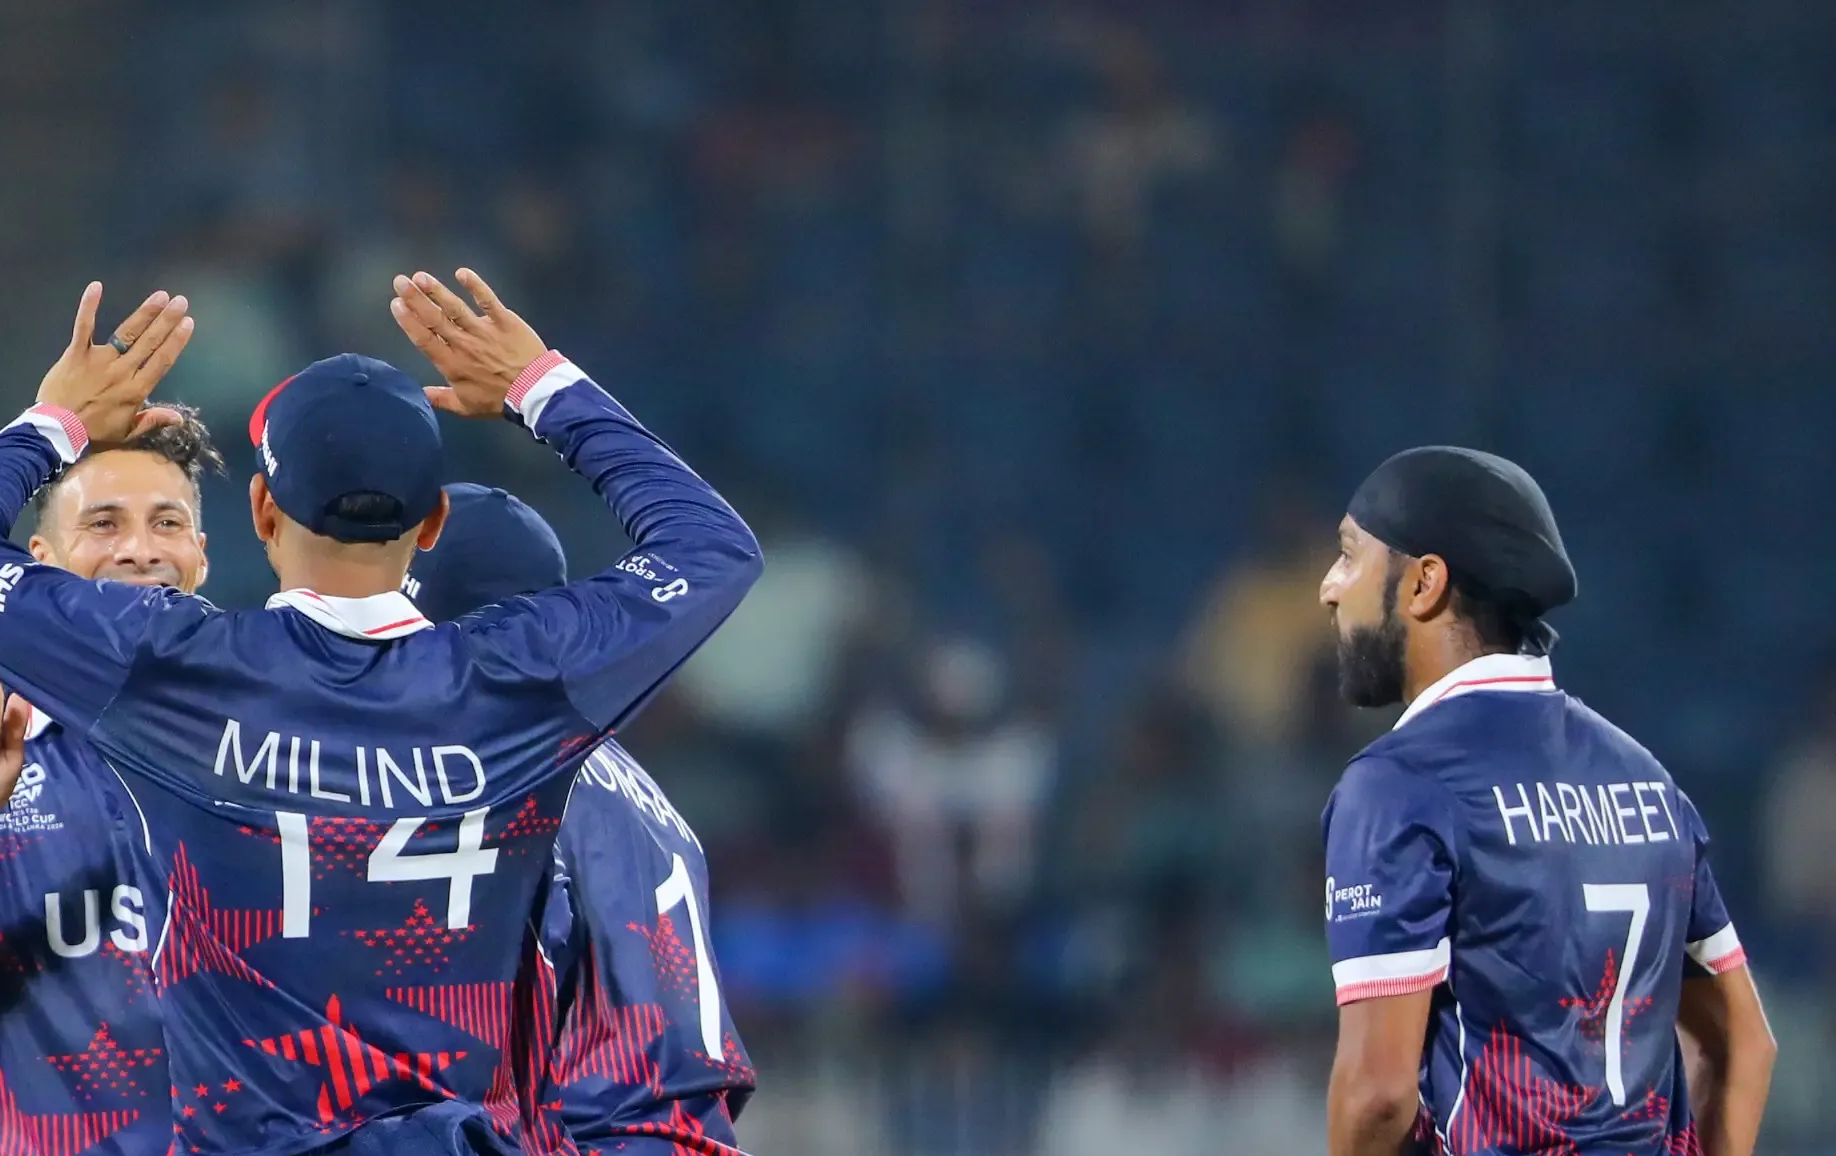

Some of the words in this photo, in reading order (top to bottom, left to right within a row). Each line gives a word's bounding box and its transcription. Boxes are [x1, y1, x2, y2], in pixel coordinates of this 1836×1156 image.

[214, 718, 487, 809] MILIND
[31, 814, 55, 824] CUP
[1491, 781, 1680, 846] HARMEET
[275, 806, 500, 939] 14
[1334, 883, 1373, 903] PEROT
[1350, 894, 1382, 911] JAIN
[44, 883, 149, 958] US
[655, 851, 726, 1063] 1
[1582, 883, 1651, 1106] 7
